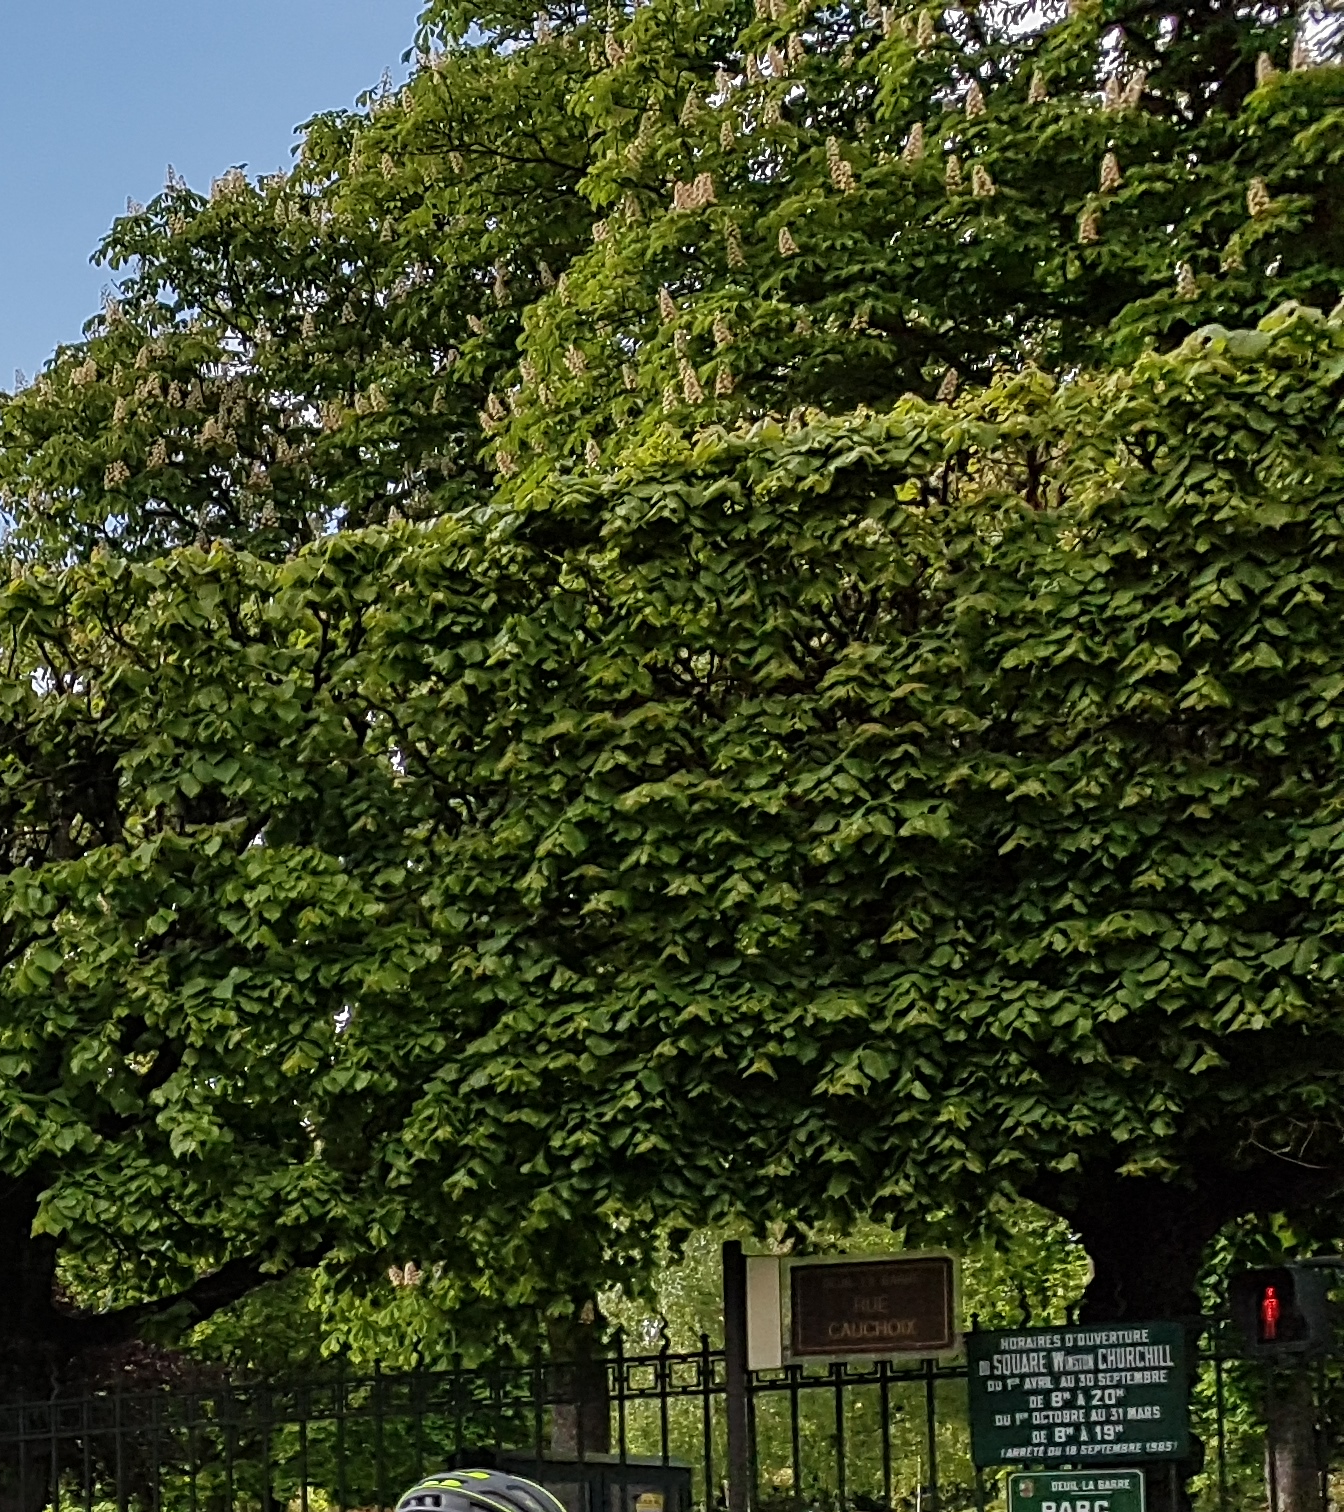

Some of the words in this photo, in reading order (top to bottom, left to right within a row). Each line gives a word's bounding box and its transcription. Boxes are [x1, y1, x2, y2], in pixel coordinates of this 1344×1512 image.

[1001, 1335, 1061, 1350] HORAIRES
[1065, 1330, 1149, 1347] D'OUVERTURE
[993, 1352, 1047, 1375] SQUARE
[1098, 1345, 1175, 1369] CHURCHILL
[987, 1380, 1003, 1392] DU
[1024, 1376, 1054, 1389] AVRIL
[1060, 1374, 1075, 1388] AU
[1078, 1373, 1094, 1387] 30
[1098, 1370, 1168, 1386] SEPTEMBRE
[1029, 1395, 1044, 1409] DE
[995, 1414, 1011, 1426] DU
[1032, 1409, 1086, 1424] OCTOBRE
[1091, 1408, 1106, 1422] AU
[1110, 1407, 1124, 1420] 31
[1127, 1405, 1161, 1419] MARS
[1032, 1430, 1048, 1444] DE
[1047, 1446, 1062, 1457] DU
[1065, 1445, 1078, 1456] 18
[1080, 1442, 1143, 1455] SEPTEMBRE
